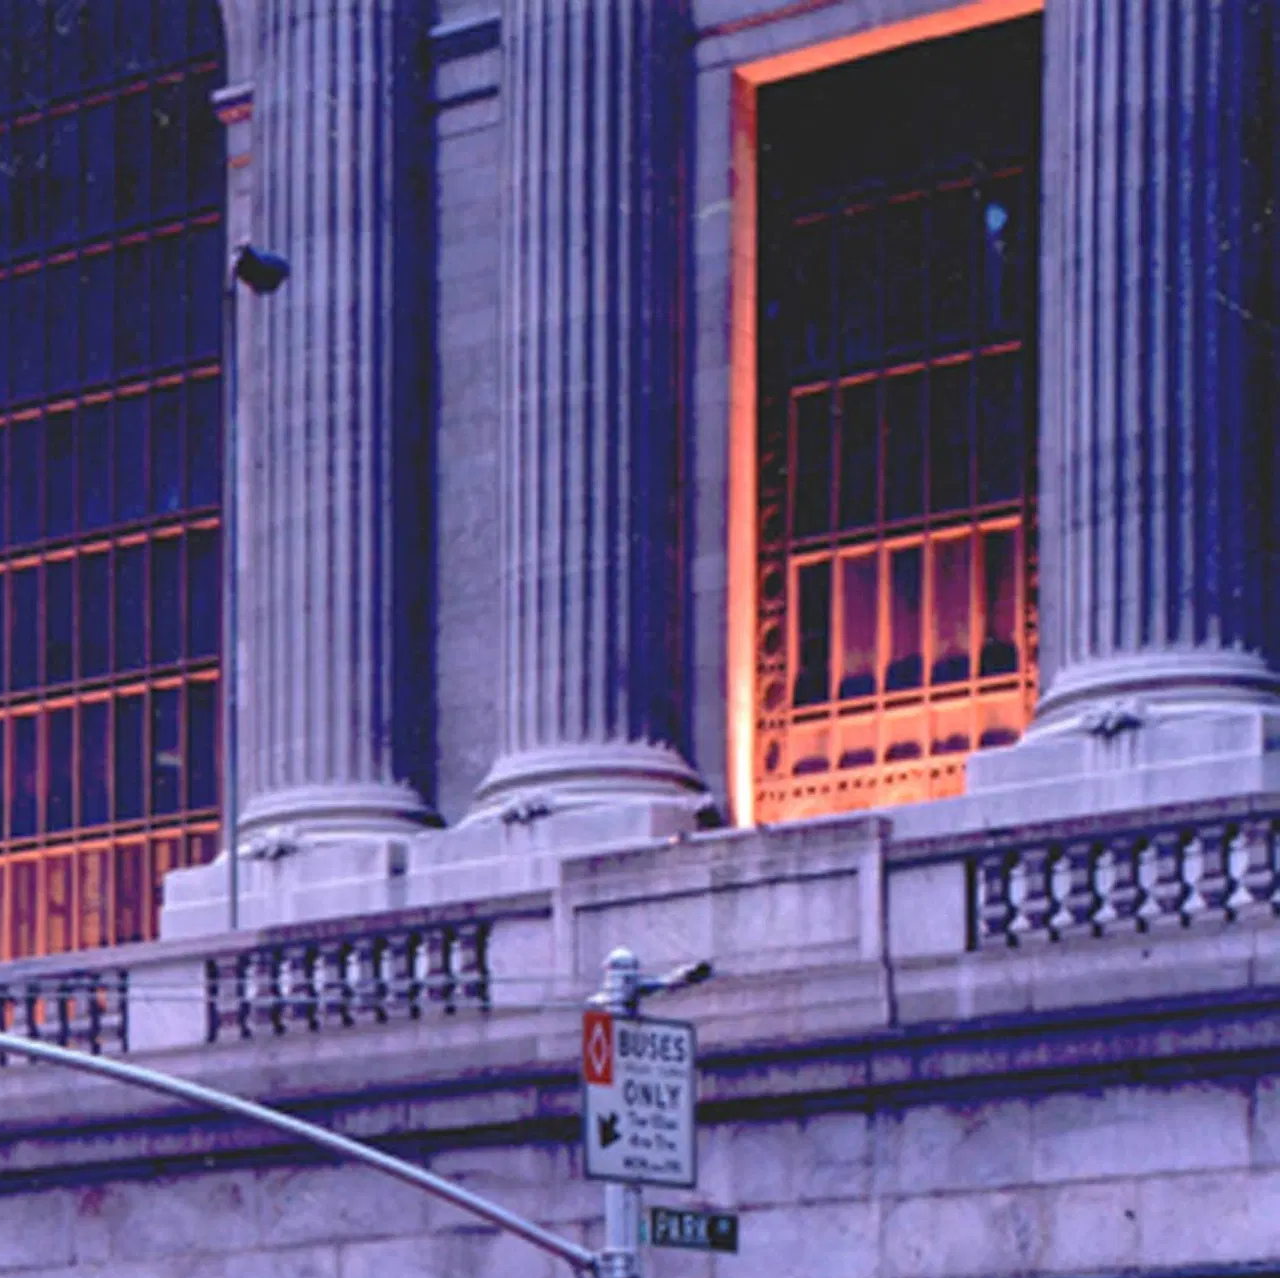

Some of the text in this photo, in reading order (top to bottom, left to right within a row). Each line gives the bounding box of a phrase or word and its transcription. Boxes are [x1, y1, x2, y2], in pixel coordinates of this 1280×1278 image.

[618, 1029, 686, 1063] BUSES
[623, 1078, 682, 1110] ONLY
[654, 1210, 708, 1242] PARK
